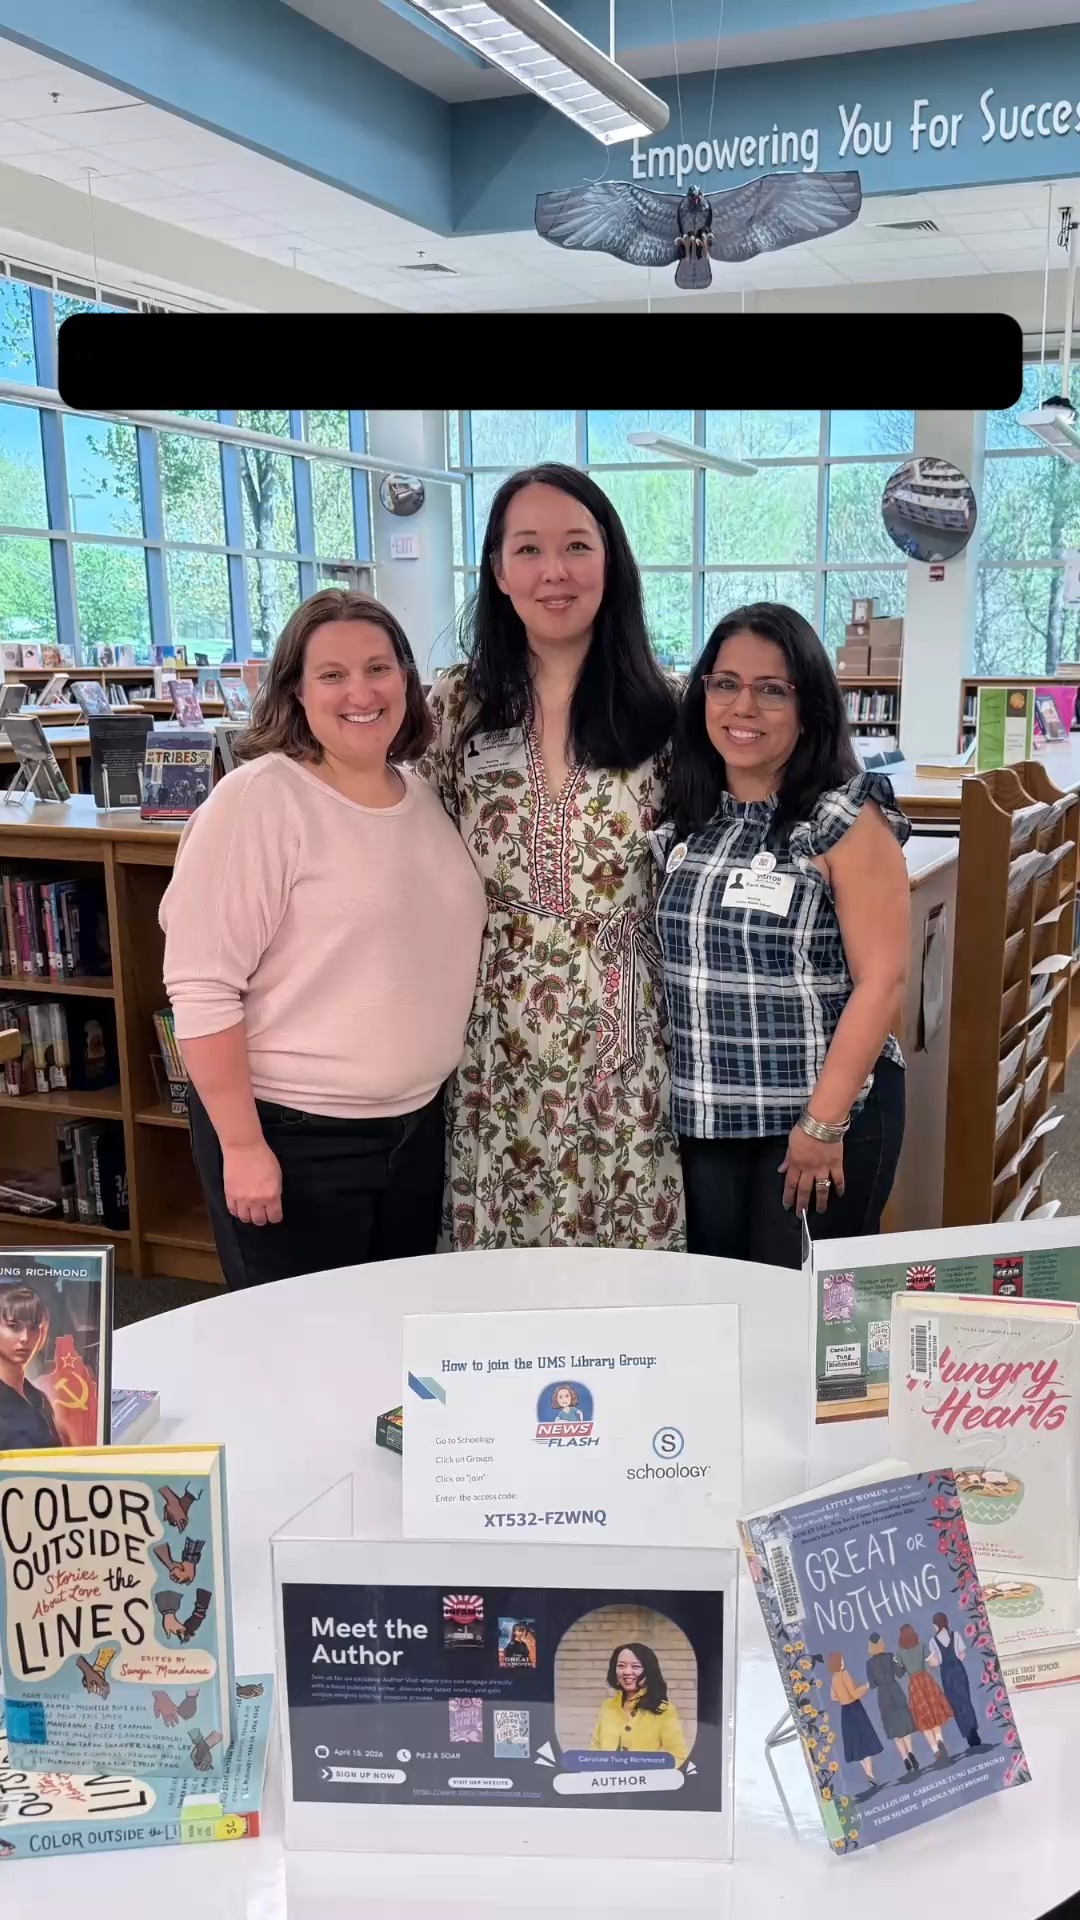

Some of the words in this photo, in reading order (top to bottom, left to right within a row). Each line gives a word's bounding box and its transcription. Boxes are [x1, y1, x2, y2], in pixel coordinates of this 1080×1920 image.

[630, 123, 819, 186] Empowering
[838, 103, 892, 157] You
[910, 99, 964, 151] For
[156, 751, 198, 763] TRIBES
[25, 1268, 88, 1277] RICHMOND
[441, 1359, 467, 1373] How
[472, 1360, 483, 1372] to
[487, 1358, 510, 1373] join
[514, 1357, 533, 1370] the
[538, 1355, 566, 1369] UMS
[570, 1355, 615, 1370] Library
[619, 1354, 657, 1370] Group:
[907, 1346, 1064, 1399] ungry
[922, 1386, 1072, 1435] Hearts
[538, 1423, 590, 1435] NEWS
[435, 1437, 447, 1445] Go
[457, 1436, 495, 1444] Schoology
[548, 1436, 600, 1447] FLASH
[661, 1433, 675, 1453] S
[435, 1456, 455, 1464] Click
[466, 1455, 494, 1463] Groups
[435, 1475, 454, 1483] Click
[498, 1492, 518, 1500] code:
[825, 1495, 855, 1510] LITTLE
[856, 1487, 889, 1502] WOMEN
[1, 1483, 155, 1554] COLOR
[484, 1509, 607, 1528] XT532-FZWNQ
[13, 1528, 145, 1591] OUTSIDE
[805, 1527, 898, 1592] GREAT
[906, 1533, 927, 1551] OR
[44, 1568, 98, 1594] Stories
[103, 1566, 141, 1591] the
[32, 1590, 67, 1620] About
[68, 1584, 101, 1603] Love
[813, 1563, 941, 1636] NOTHING
[15, 1597, 149, 1675] LINES
[311, 1616, 379, 1639] Meet
[384, 1617, 428, 1639] the
[141, 1655, 175, 1663] EDITED
[312, 1643, 404, 1666] Author
[120, 1663, 151, 1681] Sangu
[156, 1664, 210, 1676] Mandanna
[496, 1728, 518, 1741] LINES
[334, 1749, 350, 1757] April
[365, 1750, 384, 1758] 2026
[578, 1755, 609, 1763] Caroline
[611, 1756, 628, 1764] Tung
[630, 1756, 665, 1764] Richmond
[335, 1770, 357, 1778] SIGN
[359, 1771, 372, 1779] UP
[591, 1776, 647, 1788] AUTHOR
[850, 1812, 863, 1823] JOY
[913, 1779, 947, 1797] CAROLINE
[948, 1770, 966, 1783] TUNG
[966, 1756, 1005, 1776] RICHMOND
[873, 1815, 891, 1827] TESS
[891, 1803, 919, 1819] SHARPE
[921, 1791, 948, 1808] JESSICA
[948, 1774, 989, 1795] SPOTSWOOD
[29, 1831, 84, 1852] COLOR
[88, 1828, 145, 1845] OUTSIDE
[148, 1827, 164, 1837] the
